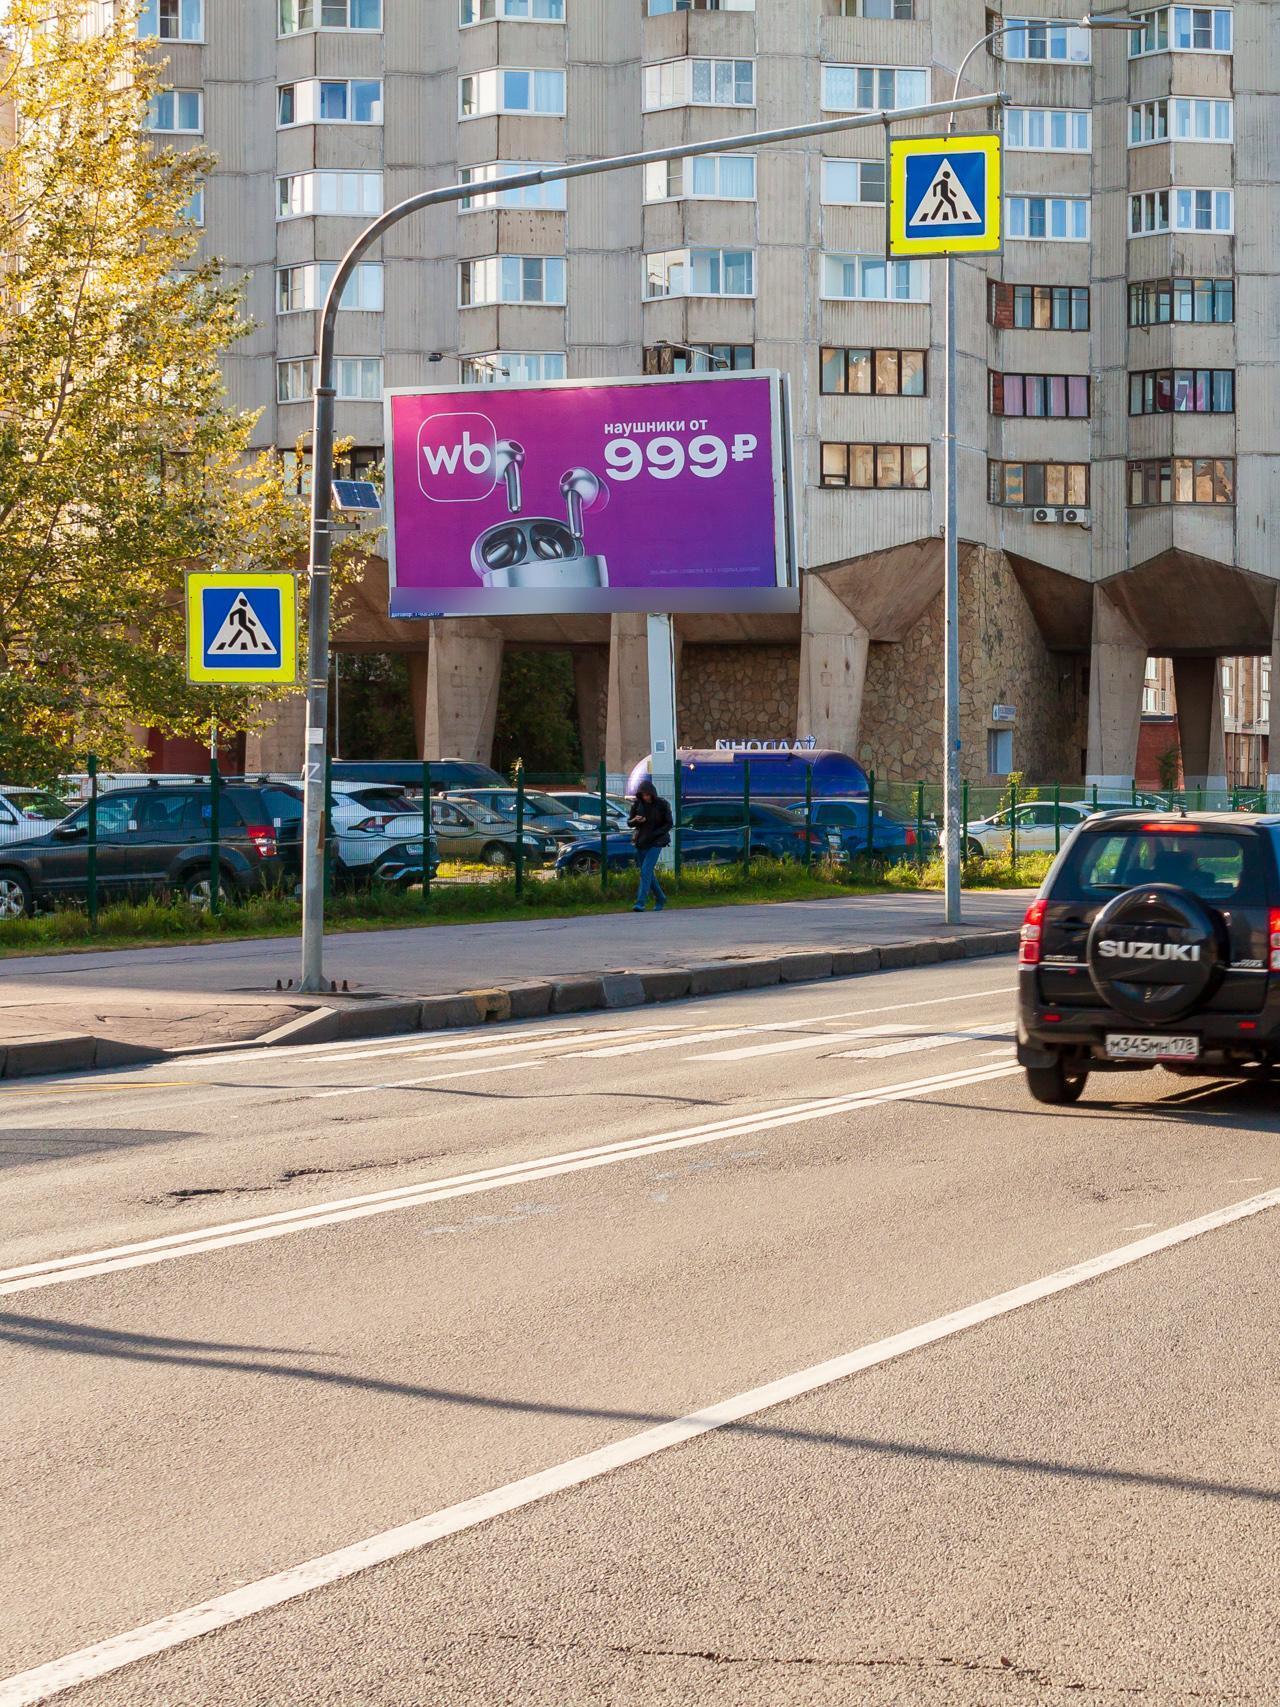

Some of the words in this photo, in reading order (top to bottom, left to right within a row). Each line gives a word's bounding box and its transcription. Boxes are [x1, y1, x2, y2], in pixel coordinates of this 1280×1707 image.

[604, 421, 686, 437] наушники
[689, 419, 708, 431] от
[422, 431, 491, 475] wb
[1098, 940, 1201, 962] SUZUKI
[1110, 1037, 1169, 1053] М345МН
[1170, 1038, 1195, 1051] 178
